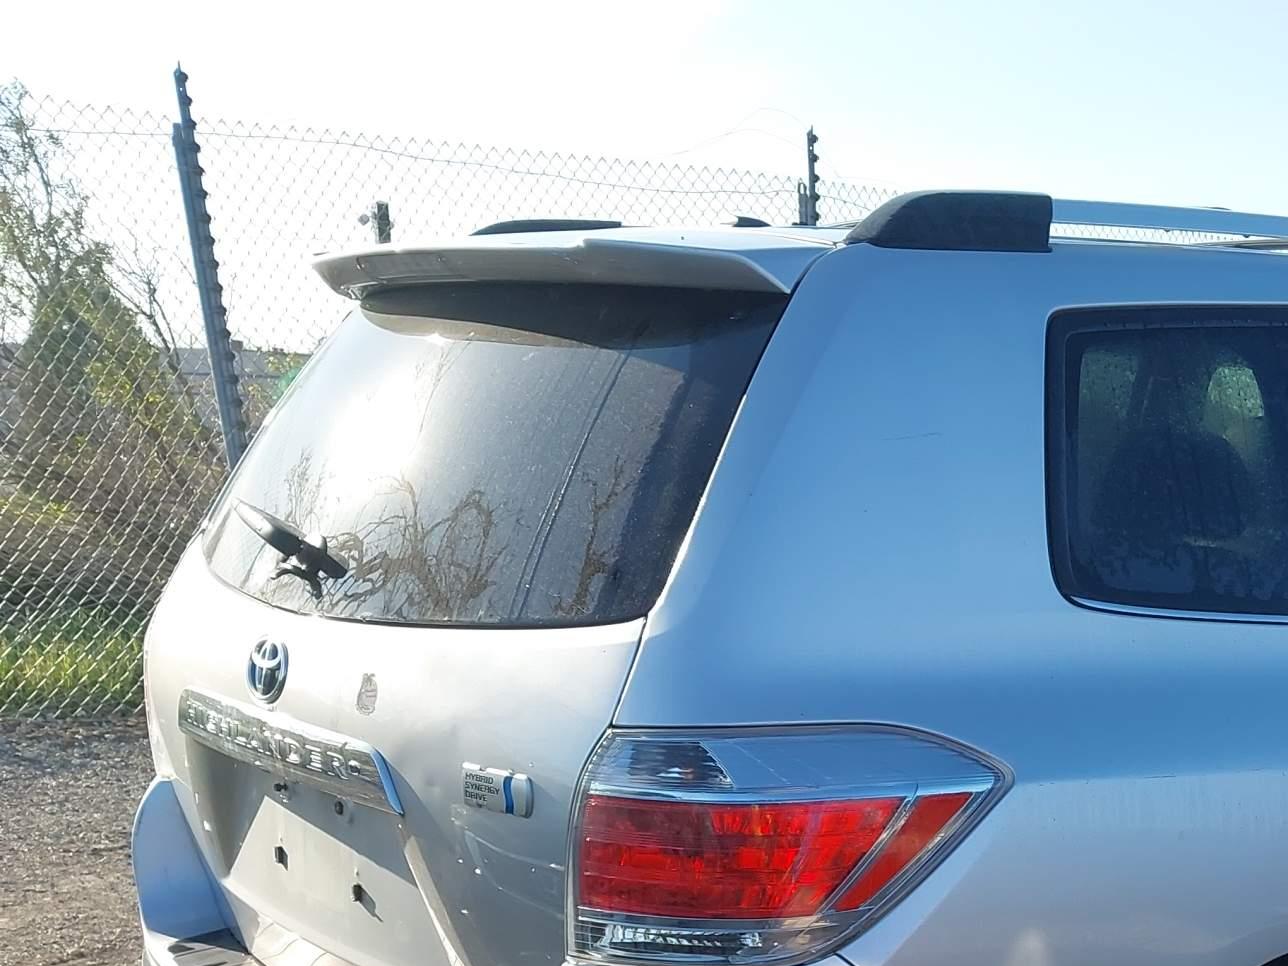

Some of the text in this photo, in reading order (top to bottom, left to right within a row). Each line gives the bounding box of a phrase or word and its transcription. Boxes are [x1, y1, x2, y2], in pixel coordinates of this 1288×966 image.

[464, 772, 494, 785] HYBRID
[464, 781, 500, 795] SYNERGY
[464, 789, 488, 802] DRIVE
